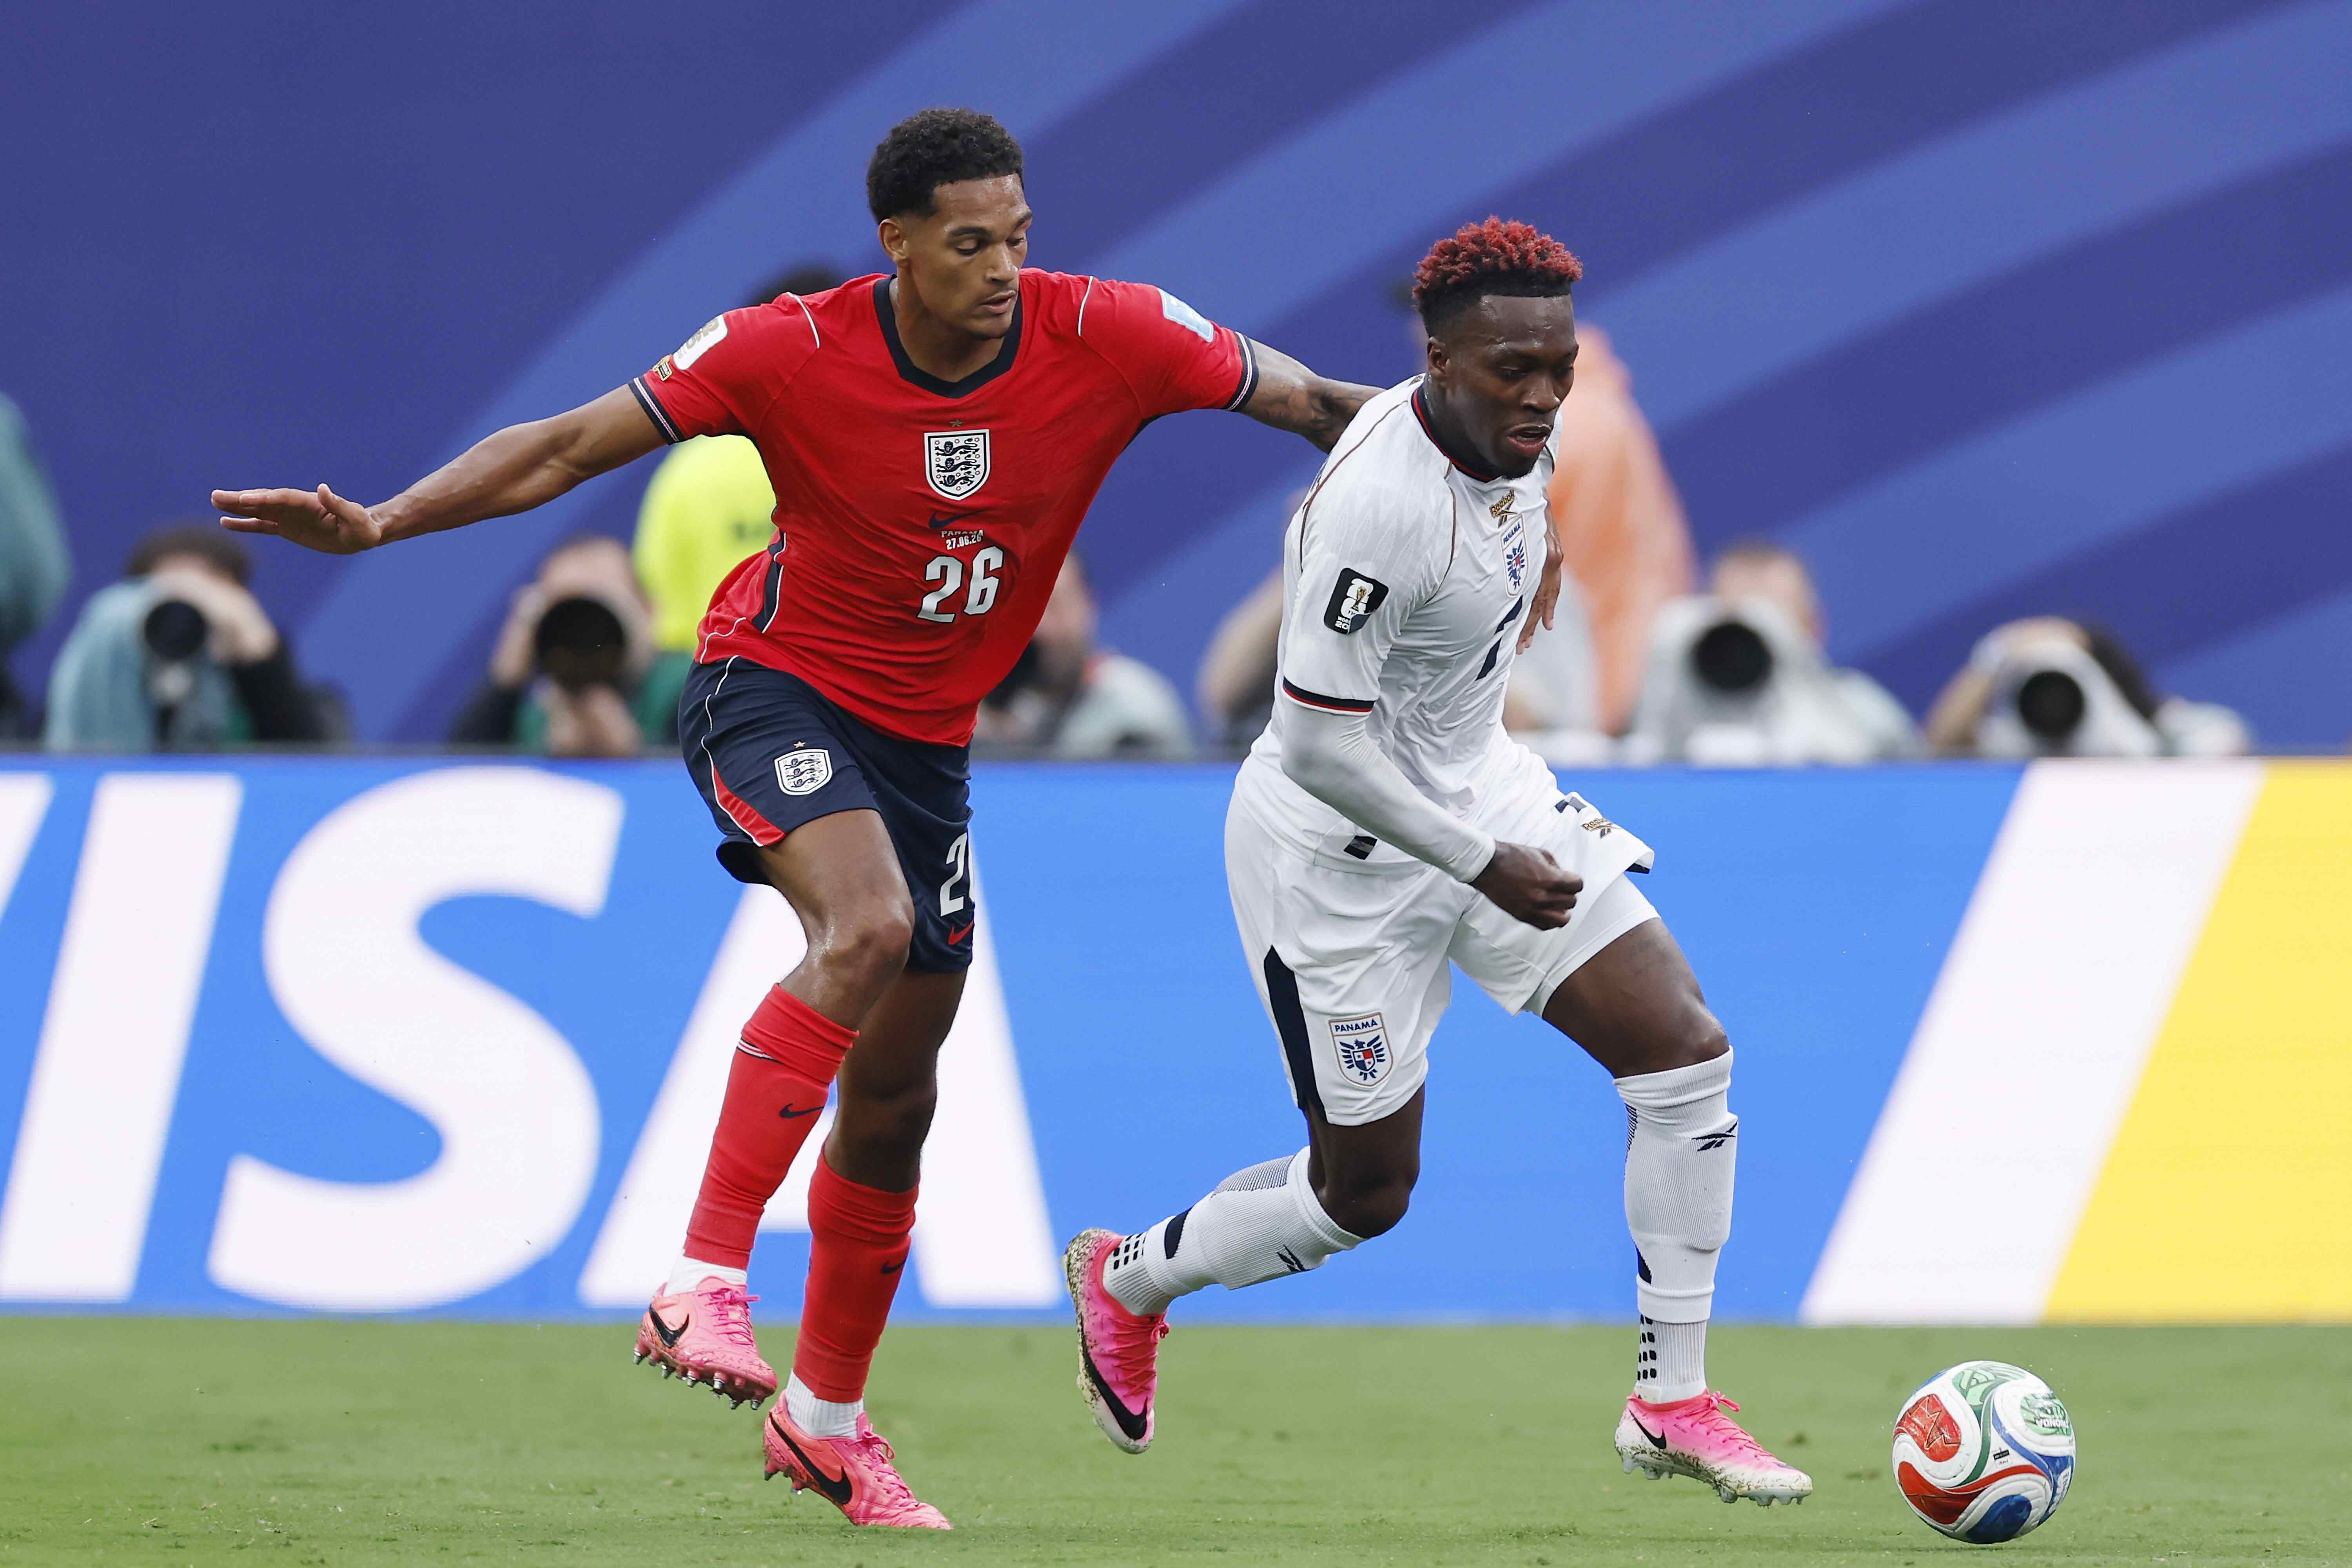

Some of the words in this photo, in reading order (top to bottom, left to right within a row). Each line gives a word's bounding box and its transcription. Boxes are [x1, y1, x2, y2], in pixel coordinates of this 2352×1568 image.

[946, 534, 982, 550] 27.06.26
[1503, 521, 1521, 545] PANAMA
[917, 546, 1004, 623] 26
[1335, 621, 1350, 630] 20
[940, 832, 975, 916] 2
[1334, 1018, 1378, 1032] PANAMA
[0, 768, 1064, 1308] ISA
